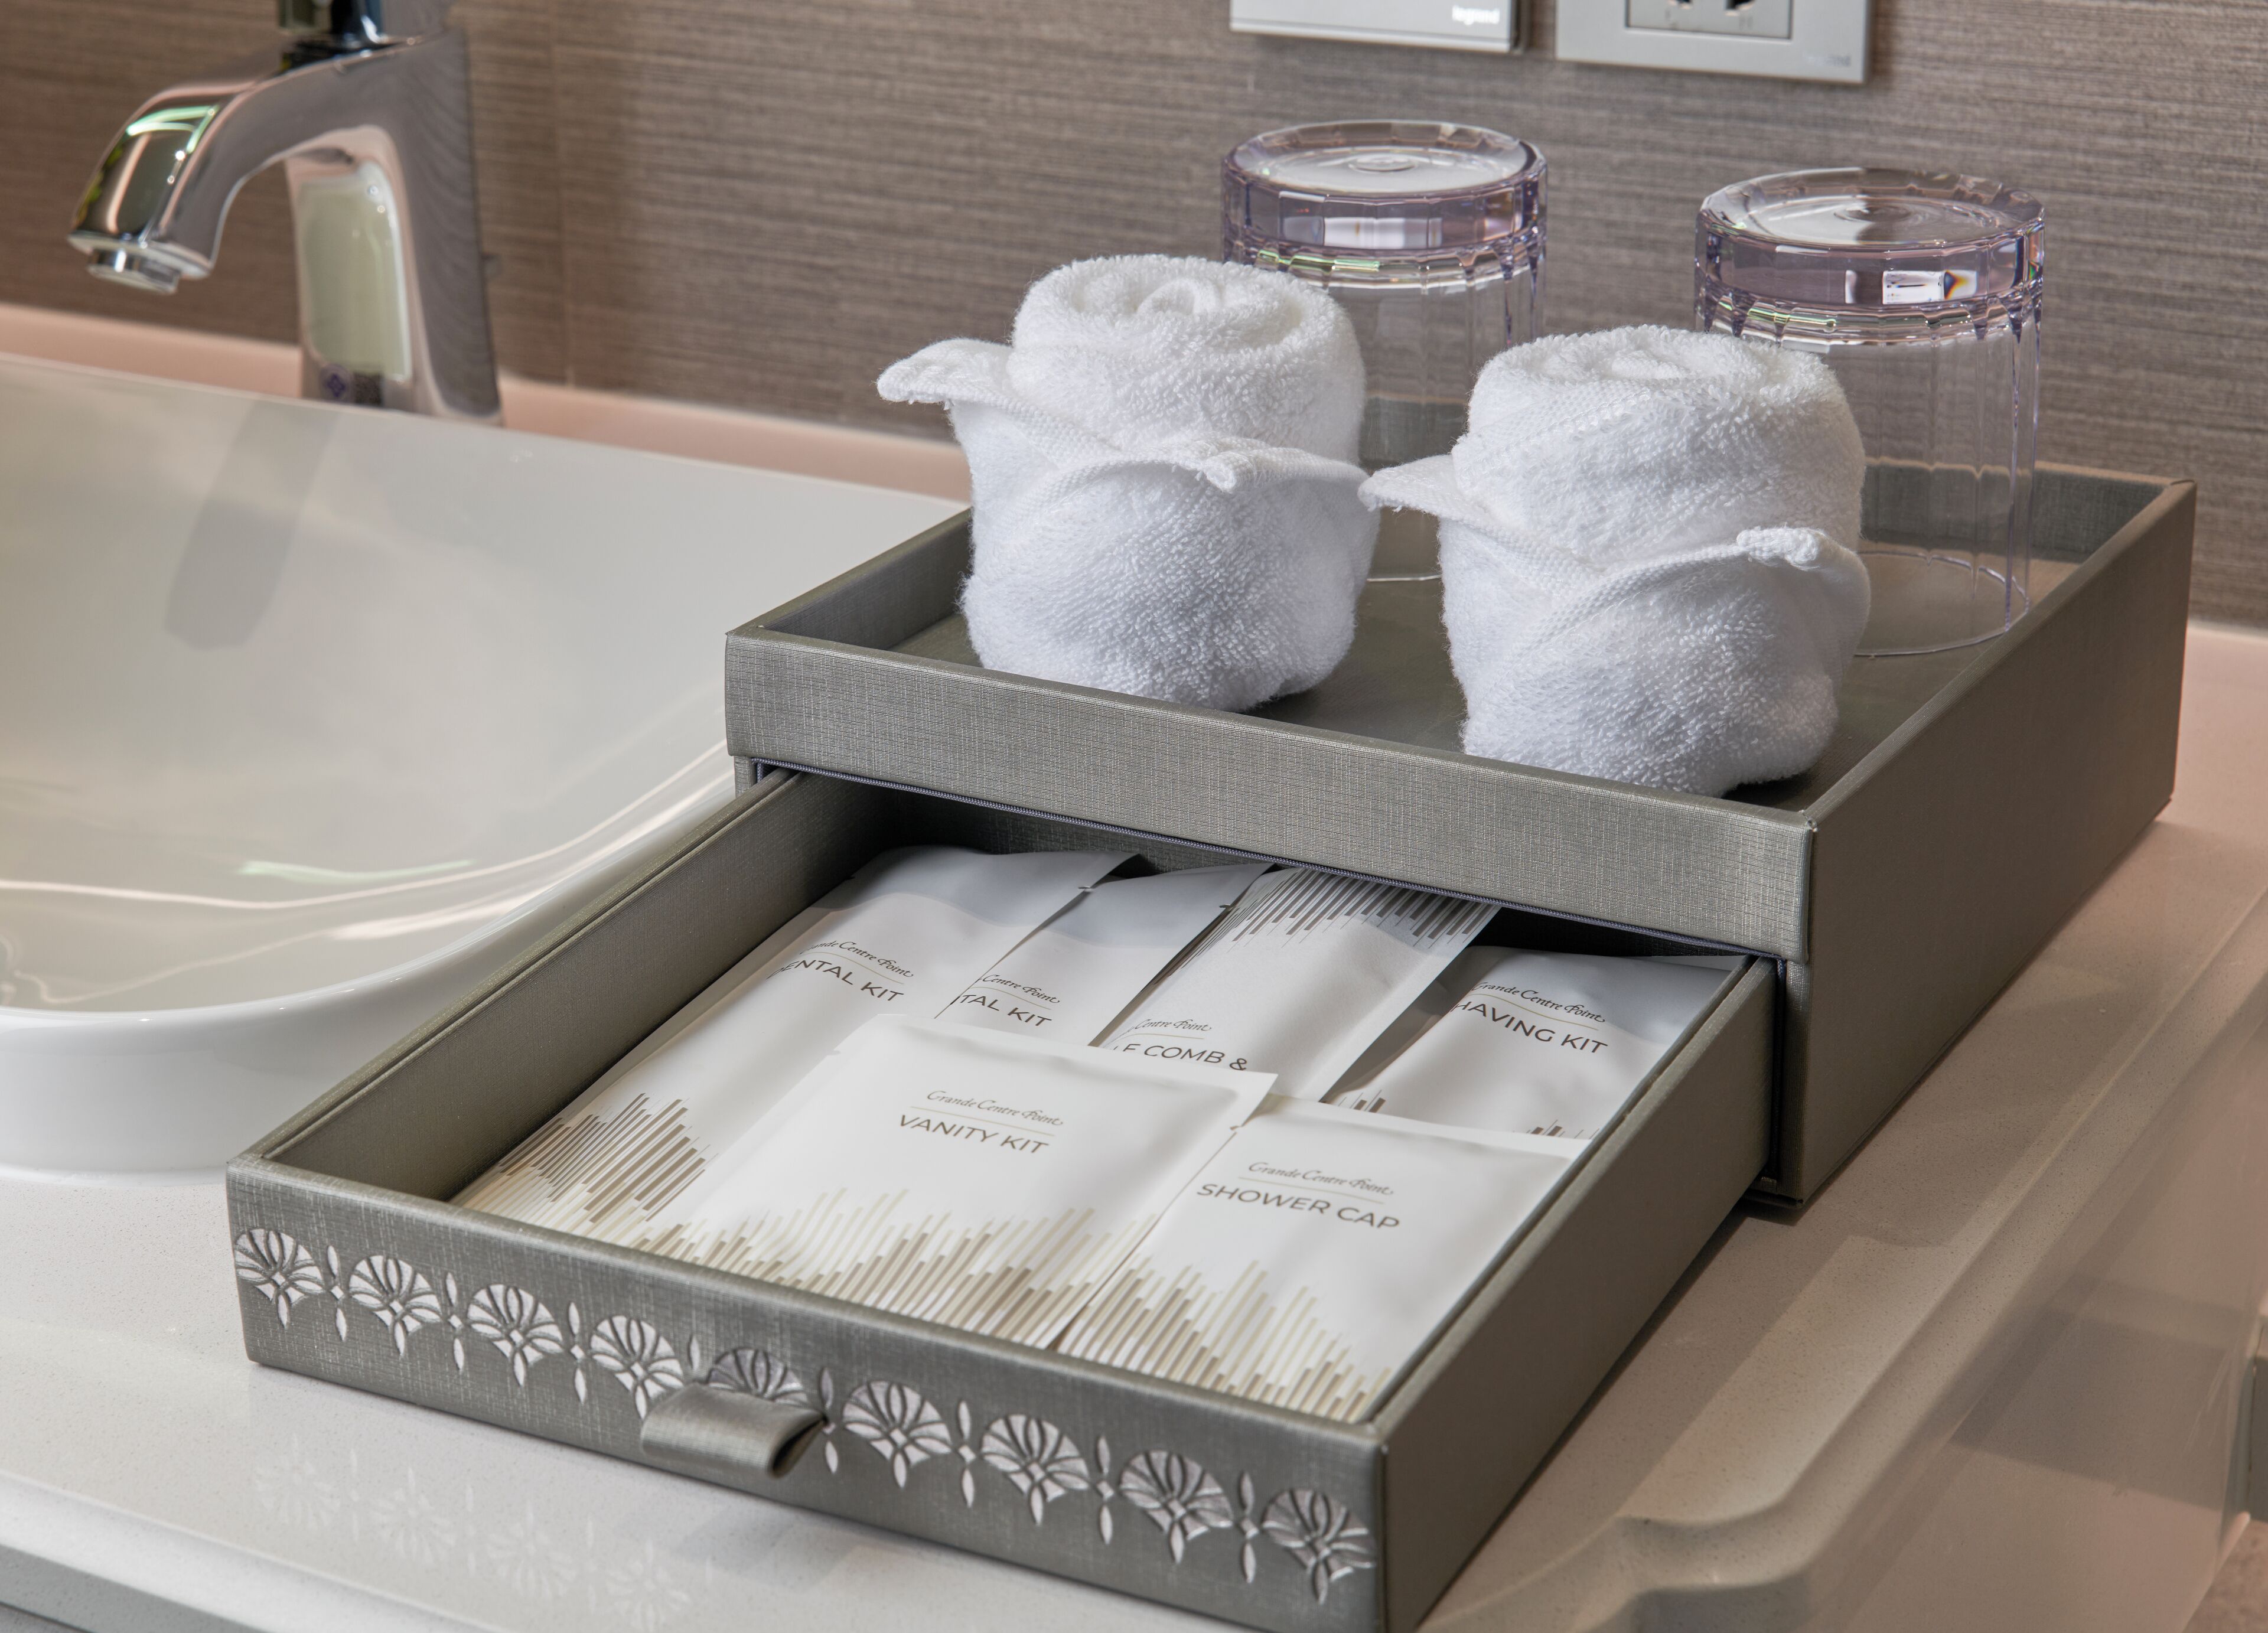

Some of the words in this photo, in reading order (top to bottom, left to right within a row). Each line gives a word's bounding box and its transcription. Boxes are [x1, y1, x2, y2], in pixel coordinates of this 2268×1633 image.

[839, 941, 877, 960] Centre
[878, 959, 914, 977] Point
[860, 982, 905, 1002] KIT
[982, 974, 1021, 989] Centre
[1022, 987, 1060, 1003] Point
[950, 994, 1000, 1012] TAL
[1007, 1007, 1052, 1026] KIT
[1520, 989, 1563, 1011] Centre
[1564, 1004, 1606, 1023] Point
[1173, 1019, 1212, 1032] Point
[1143, 1045, 1226, 1064] COMB
[1229, 1058, 1248, 1071] &
[1560, 1034, 1608, 1054] KIT
[926, 1090, 976, 1107] Grande
[977, 1099, 1020, 1116] Centre
[1021, 1109, 1064, 1126] Point
[899, 1114, 999, 1142] VANITY
[1000, 1135, 1050, 1153] KIT
[1248, 1161, 1301, 1179] Grande
[1302, 1169, 1348, 1186] Centre
[1348, 1178, 1394, 1195] Point
[1196, 1183, 1331, 1214] SHOWER
[1337, 1207, 1400, 1229] CAP
